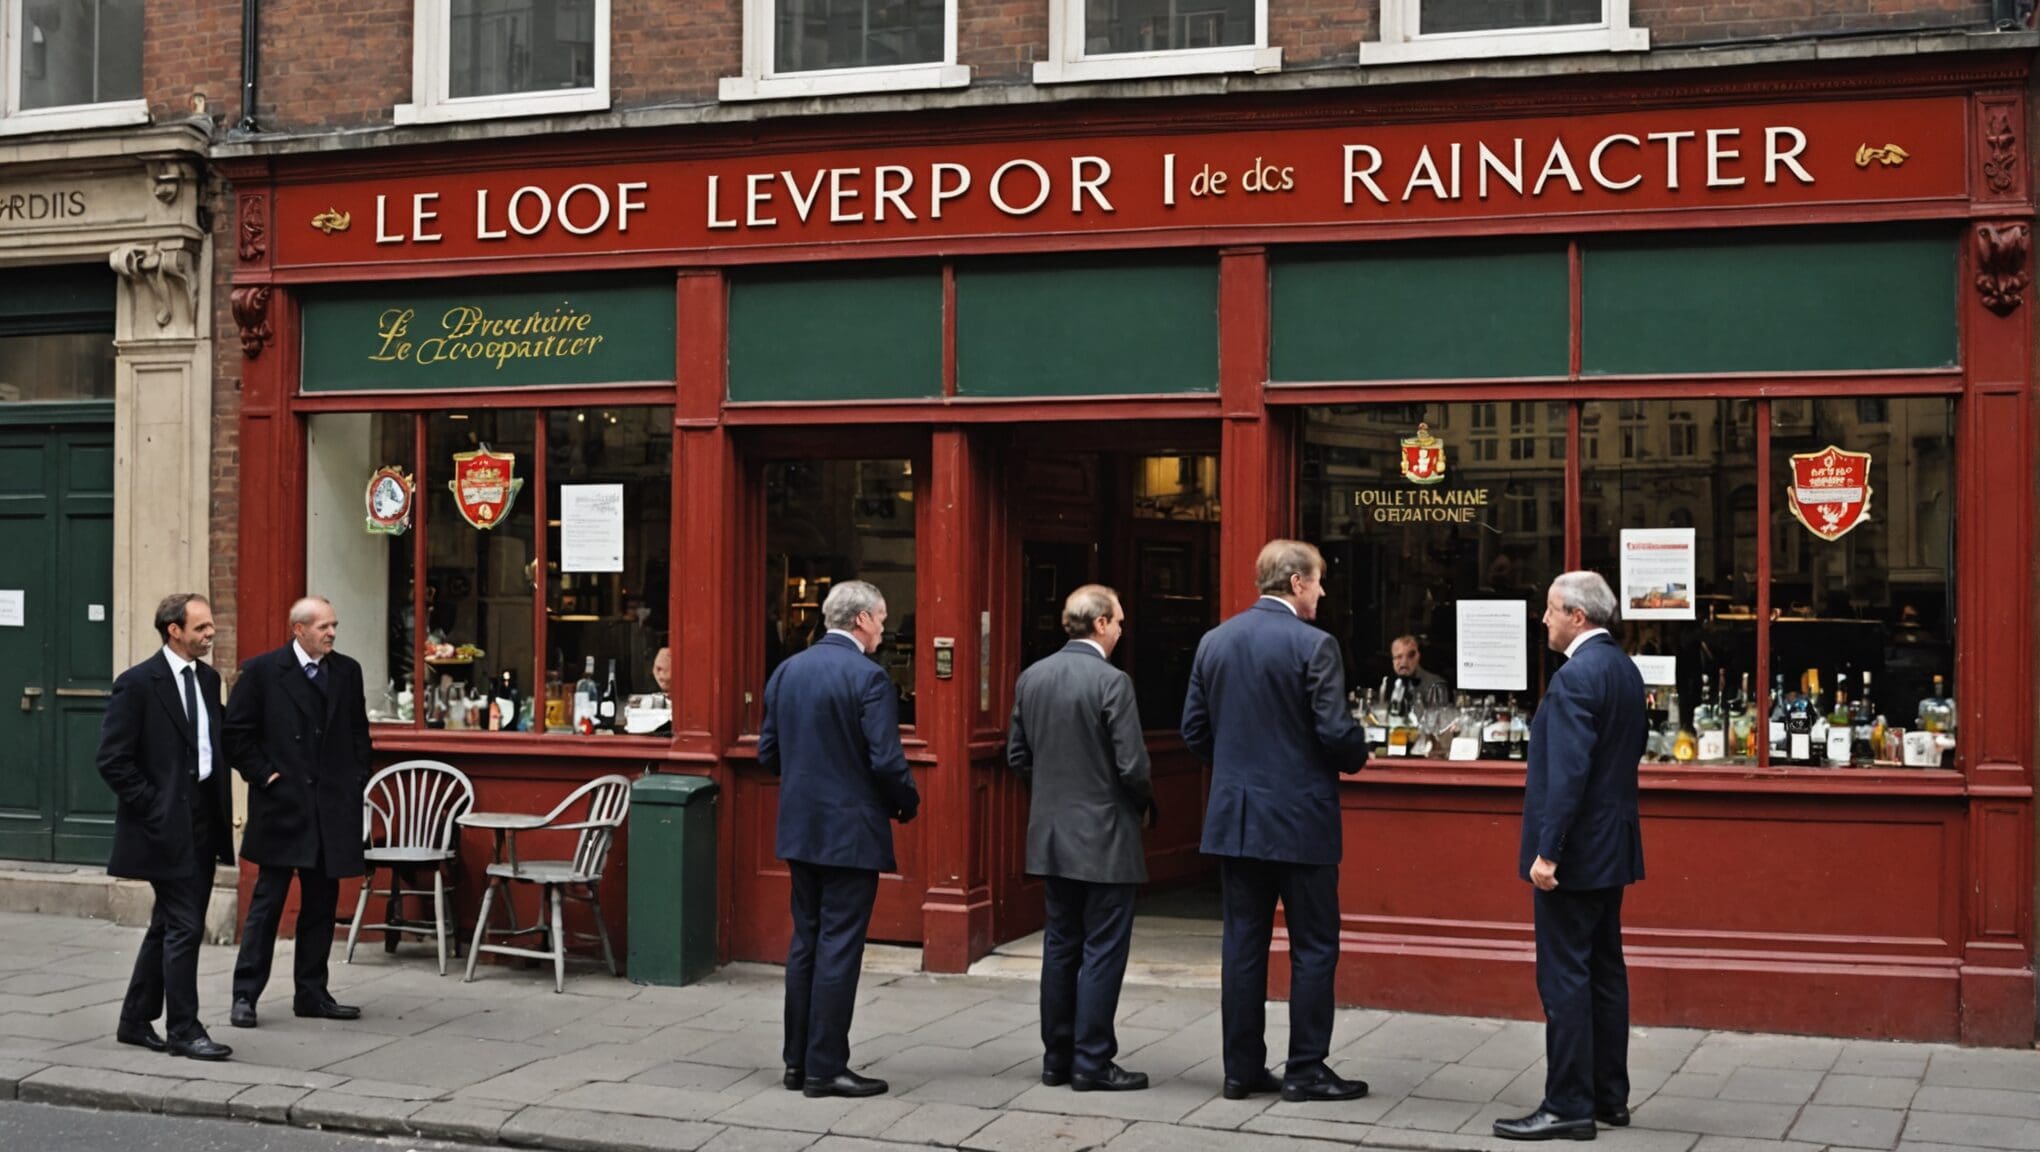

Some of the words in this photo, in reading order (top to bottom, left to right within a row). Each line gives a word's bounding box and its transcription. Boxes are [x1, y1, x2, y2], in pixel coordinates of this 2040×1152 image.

[375, 192, 442, 243] LE
[477, 181, 648, 239] LOOF
[707, 156, 1114, 228] LEVERPOR
[1190, 163, 1228, 196] de
[1343, 126, 1815, 204] RAINACTER
